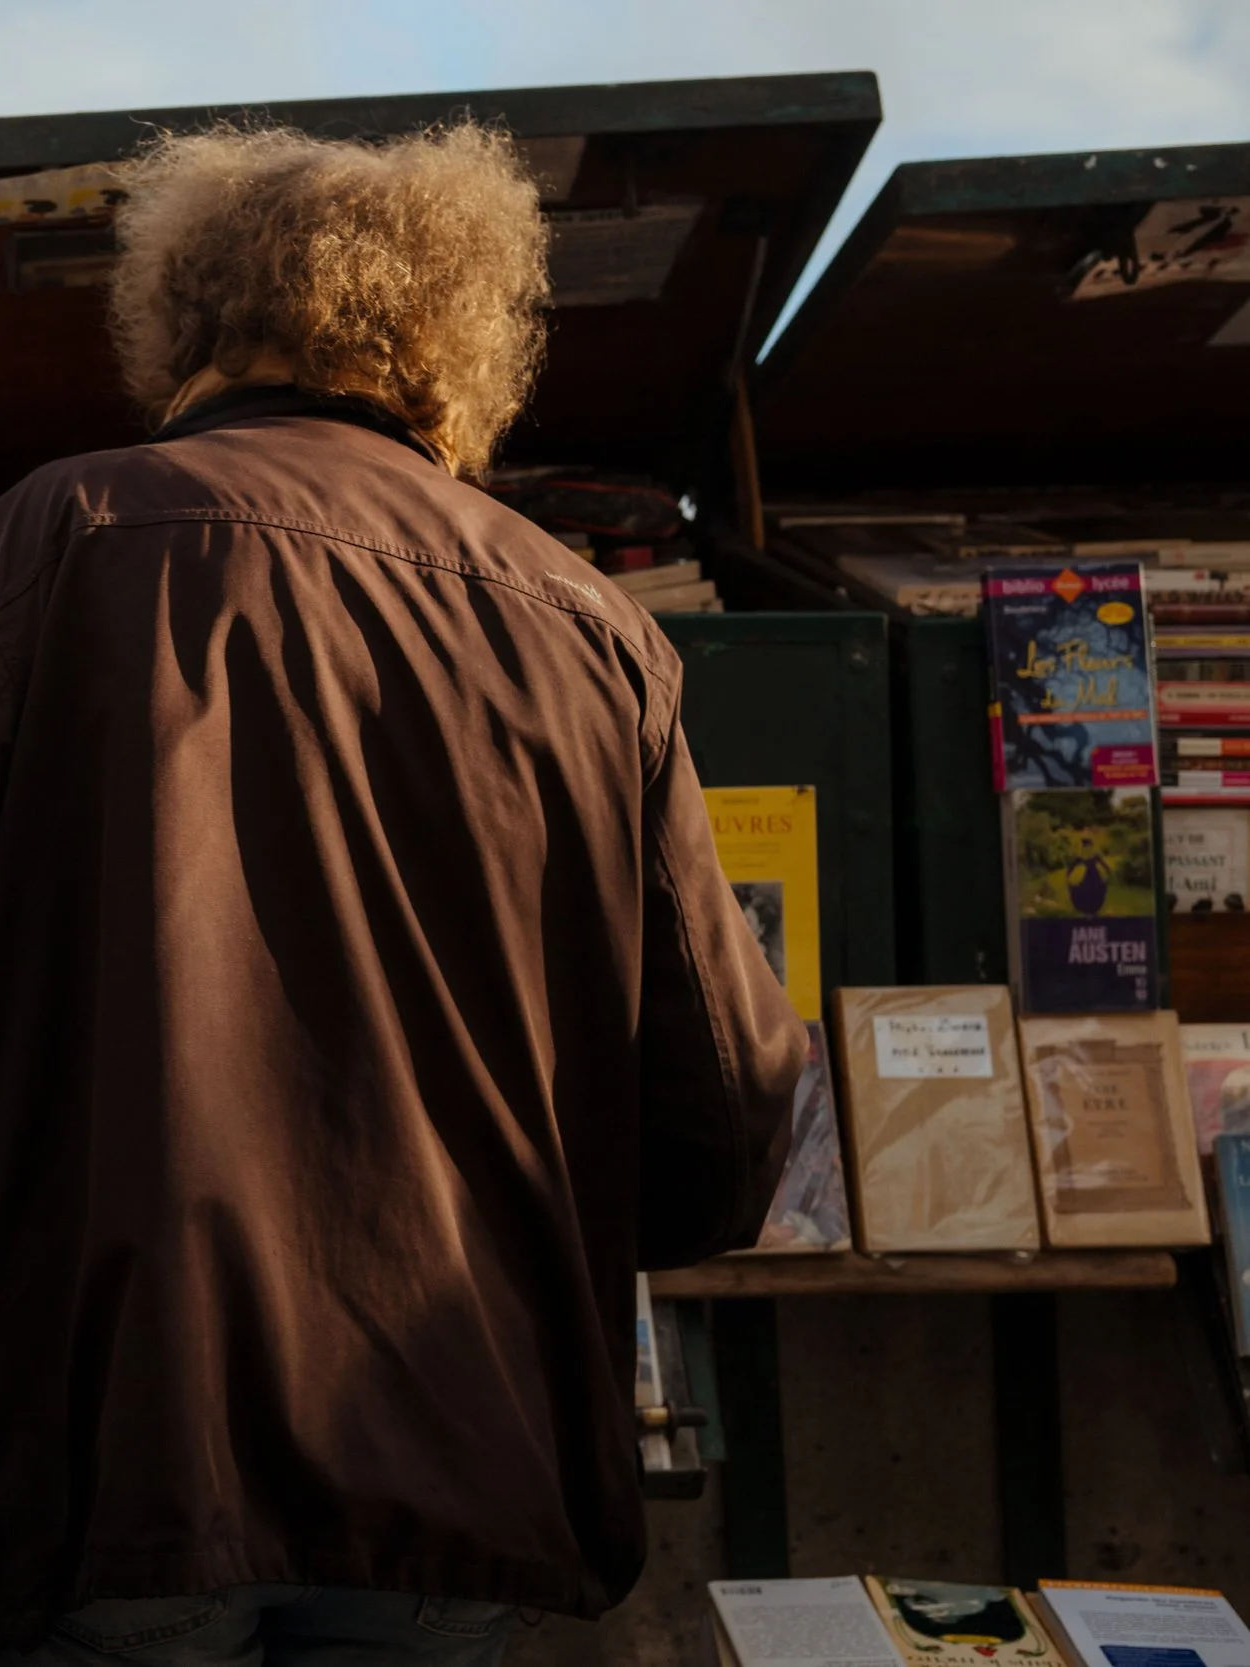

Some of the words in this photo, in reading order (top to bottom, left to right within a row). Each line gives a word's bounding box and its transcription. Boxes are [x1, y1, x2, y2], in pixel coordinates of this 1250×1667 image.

[1002, 577, 1046, 595] biblio
[1091, 575, 1130, 592] lycée
[1016, 639, 1056, 678] Les
[1056, 639, 1135, 672] Fleurs
[1071, 675, 1118, 711] Mal
[715, 815, 792, 834] UVRES
[1167, 855, 1226, 867] PASSANT
[1168, 874, 1217, 891] l-Ami
[1070, 925, 1107, 943] JANE
[1067, 941, 1147, 964] AUSTEN
